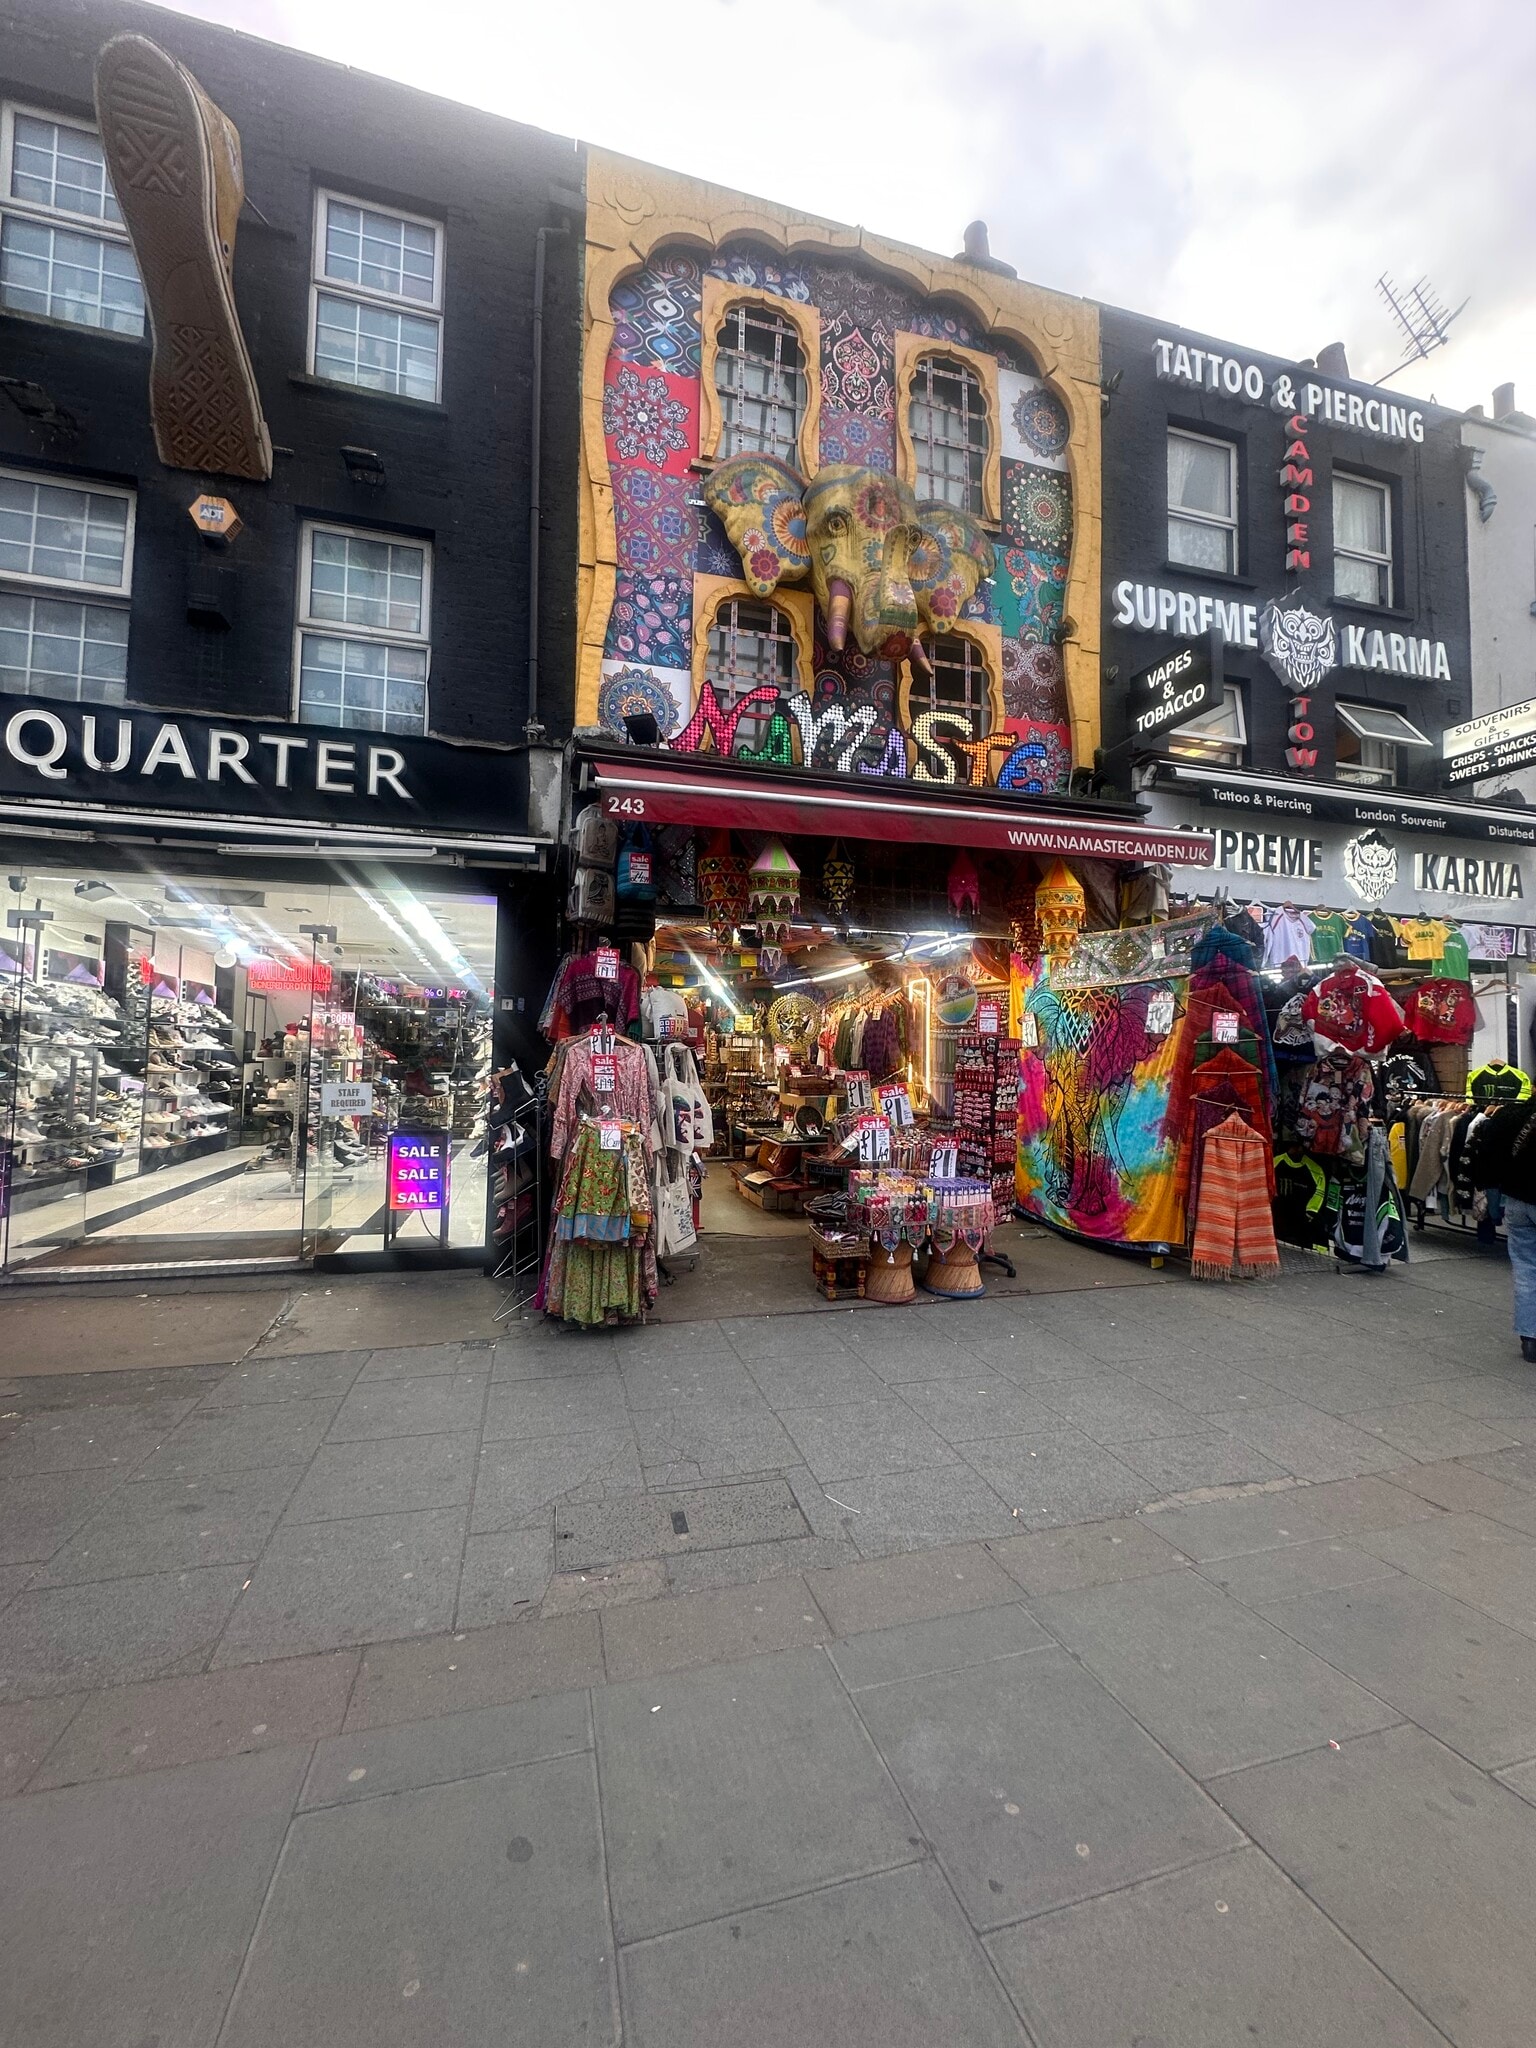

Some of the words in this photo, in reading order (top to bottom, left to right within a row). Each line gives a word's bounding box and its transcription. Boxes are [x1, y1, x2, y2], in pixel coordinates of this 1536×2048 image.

[1157, 338, 1264, 400] TATTOO
[1276, 374, 1297, 411] &
[1307, 382, 1425, 443] PIERCING
[1285, 414, 1314, 569] CAMDEN
[200, 507, 225, 520] ADT
[1116, 580, 1258, 648] SUPREME
[1349, 624, 1452, 682] KARMA
[1146, 649, 1193, 690] VAPES
[1162, 681, 1176, 700] &
[1136, 683, 1206, 733] TOBACCO
[1454, 703, 1532, 737] SOUVENIRS
[668, 678, 1048, 794] NAMASTE
[1291, 696, 1319, 778] TOW
[1474, 729, 1511, 747] GIFTS
[1488, 725, 1497, 734] &
[5, 708, 414, 800] QUARTER
[1450, 750, 1487, 769] CRISPS
[1493, 734, 1536, 756] SNACKS
[1449, 761, 1490, 782] SWEETS
[608, 796, 646, 815] 243
[1212, 788, 1251, 804] Tattoo
[1253, 793, 1263, 806] &
[1265, 794, 1313, 815] Piercing
[1354, 807, 1397, 823] London
[1401, 813, 1447, 829] Souvenir
[1488, 825, 1535, 841] Disturbed
[1007, 830, 1209, 861] WWW.NAMASTECAMDEN.UK
[631, 854, 650, 863] sale
[1180, 823, 1323, 879] PREME
[1420, 852, 1524, 899] KARMA
[599, 949, 617, 958] sale
[980, 1003, 998, 1011] sale
[595, 1055, 615, 1065] sale
[848, 1072, 867, 1081] sale
[338, 1088, 360, 1097] STAFF
[881, 1085, 905, 1098] sale
[331, 1099, 366, 1108] REQUIRED
[862, 1118, 887, 1129] sale
[399, 1146, 440, 1158] SALE
[936, 1138, 957, 1149] sale
[398, 1168, 439, 1180] SALE
[397, 1191, 438, 1203] SALE
